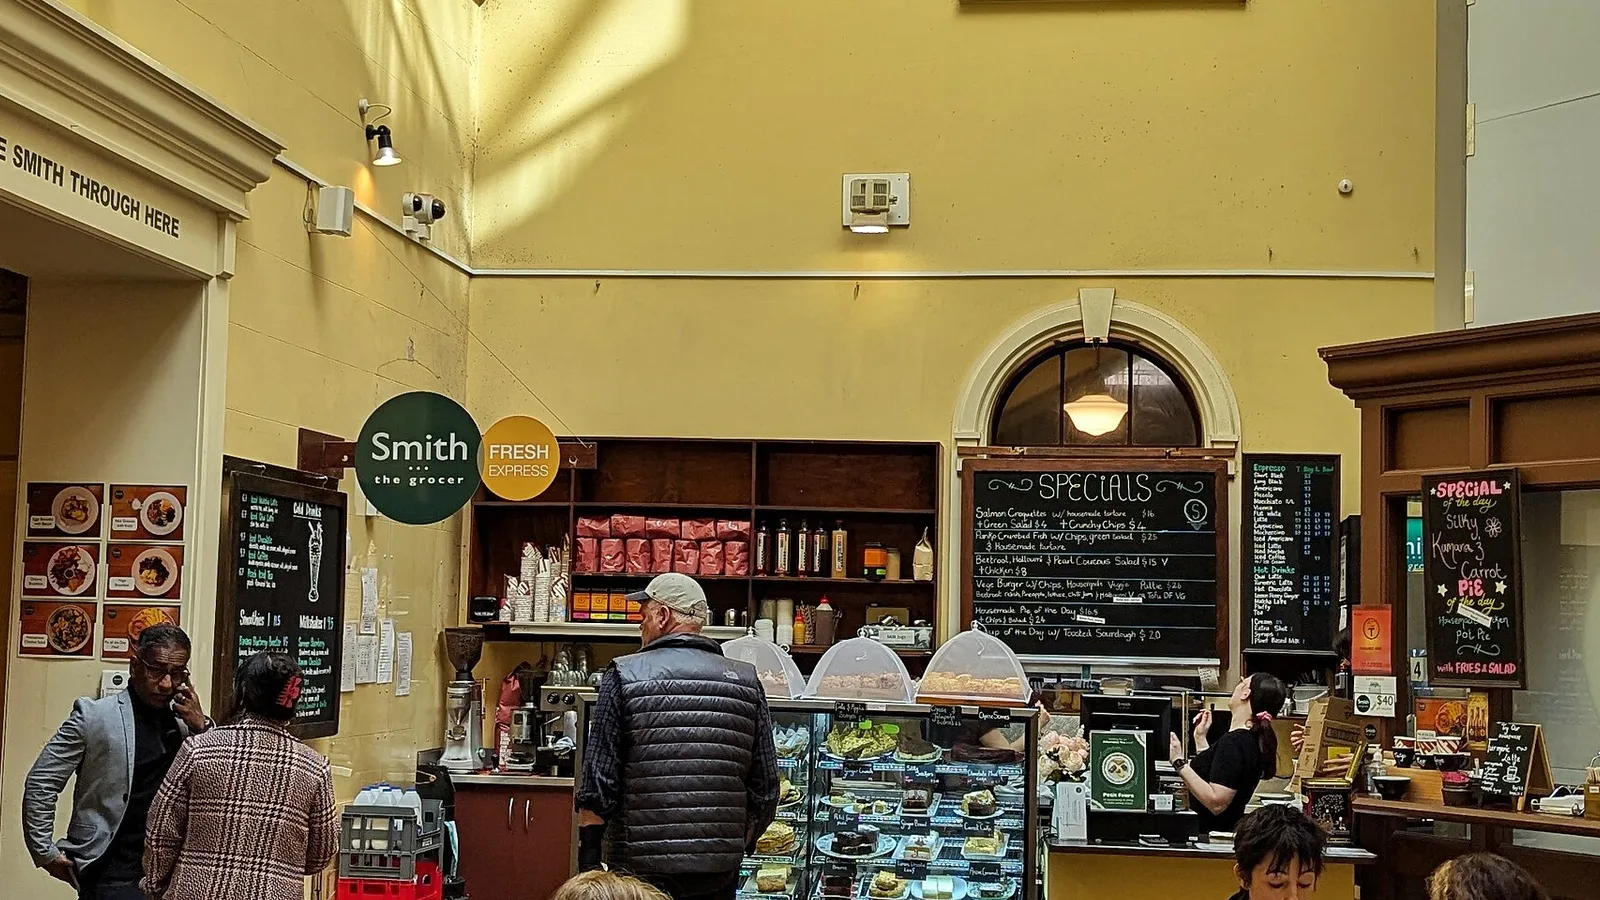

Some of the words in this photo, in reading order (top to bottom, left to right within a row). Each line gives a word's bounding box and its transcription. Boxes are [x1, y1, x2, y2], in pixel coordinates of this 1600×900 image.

[13, 145, 64, 187] SMITH
[70, 170, 140, 221] THROUGH
[145, 205, 180, 240] HERE
[371, 432, 467, 461] Smith
[489, 443, 549, 461] FRESH
[488, 464, 549, 478] EXPRESS
[1253, 463, 1286, 472] Espresso
[374, 475, 400, 485] the
[408, 475, 465, 487] grocer
[293, 502, 304, 516] Cold
[306, 503, 322, 518] Drinks
[1443, 498, 1453, 514] of
[1455, 496, 1470, 507] the
[1472, 495, 1497, 514] day
[976, 507, 1006, 518] Salmon
[1007, 508, 1047, 522] Croquettes
[1141, 508, 1155, 518] $16
[1011, 519, 1032, 529] Salad
[1102, 520, 1125, 530] Chips
[1446, 513, 1479, 540] Silky
[997, 531, 1030, 540] Crumbed
[1033, 531, 1047, 540] Fish
[1141, 532, 1158, 543] $25
[995, 541, 1036, 550] Housemade
[1039, 541, 1066, 550] tartare
[1432, 531, 1475, 569] Kumara
[1054, 555, 1075, 565] Pearl
[1115, 556, 1140, 566] Salad
[1141, 556, 1157, 568] $15
[1161, 557, 1169, 567] V
[1015, 566, 1027, 577] $8
[1254, 566, 1269, 574] Hot
[1271, 566, 1295, 574] Drinks
[1461, 561, 1508, 580] Carrot
[997, 578, 1024, 591] Burger
[1140, 580, 1163, 590] Pattie
[1147, 591, 1161, 599] Tofu
[1163, 591, 1173, 599] DF
[1174, 592, 1186, 600] VG
[1445, 597, 1456, 613] of
[1459, 595, 1474, 606] the
[1477, 593, 1505, 616] day
[975, 605, 1016, 615] Housemade
[1034, 605, 1042, 614] of
[1045, 606, 1058, 614] the
[1061, 606, 1076, 620] Day
[1004, 628, 1013, 636] of
[1029, 627, 1044, 641] Day
[1063, 628, 1092, 638] Toasted
[1096, 628, 1136, 642] Sourdough
[1477, 627, 1491, 641] Pie
[1414, 661, 1421, 679] 4
[1437, 662, 1453, 672] with
[1455, 662, 1481, 674] FRIES
[1482, 664, 1488, 673] &
[1488, 662, 1516, 674] SALAD
[1377, 695, 1393, 706] $40
